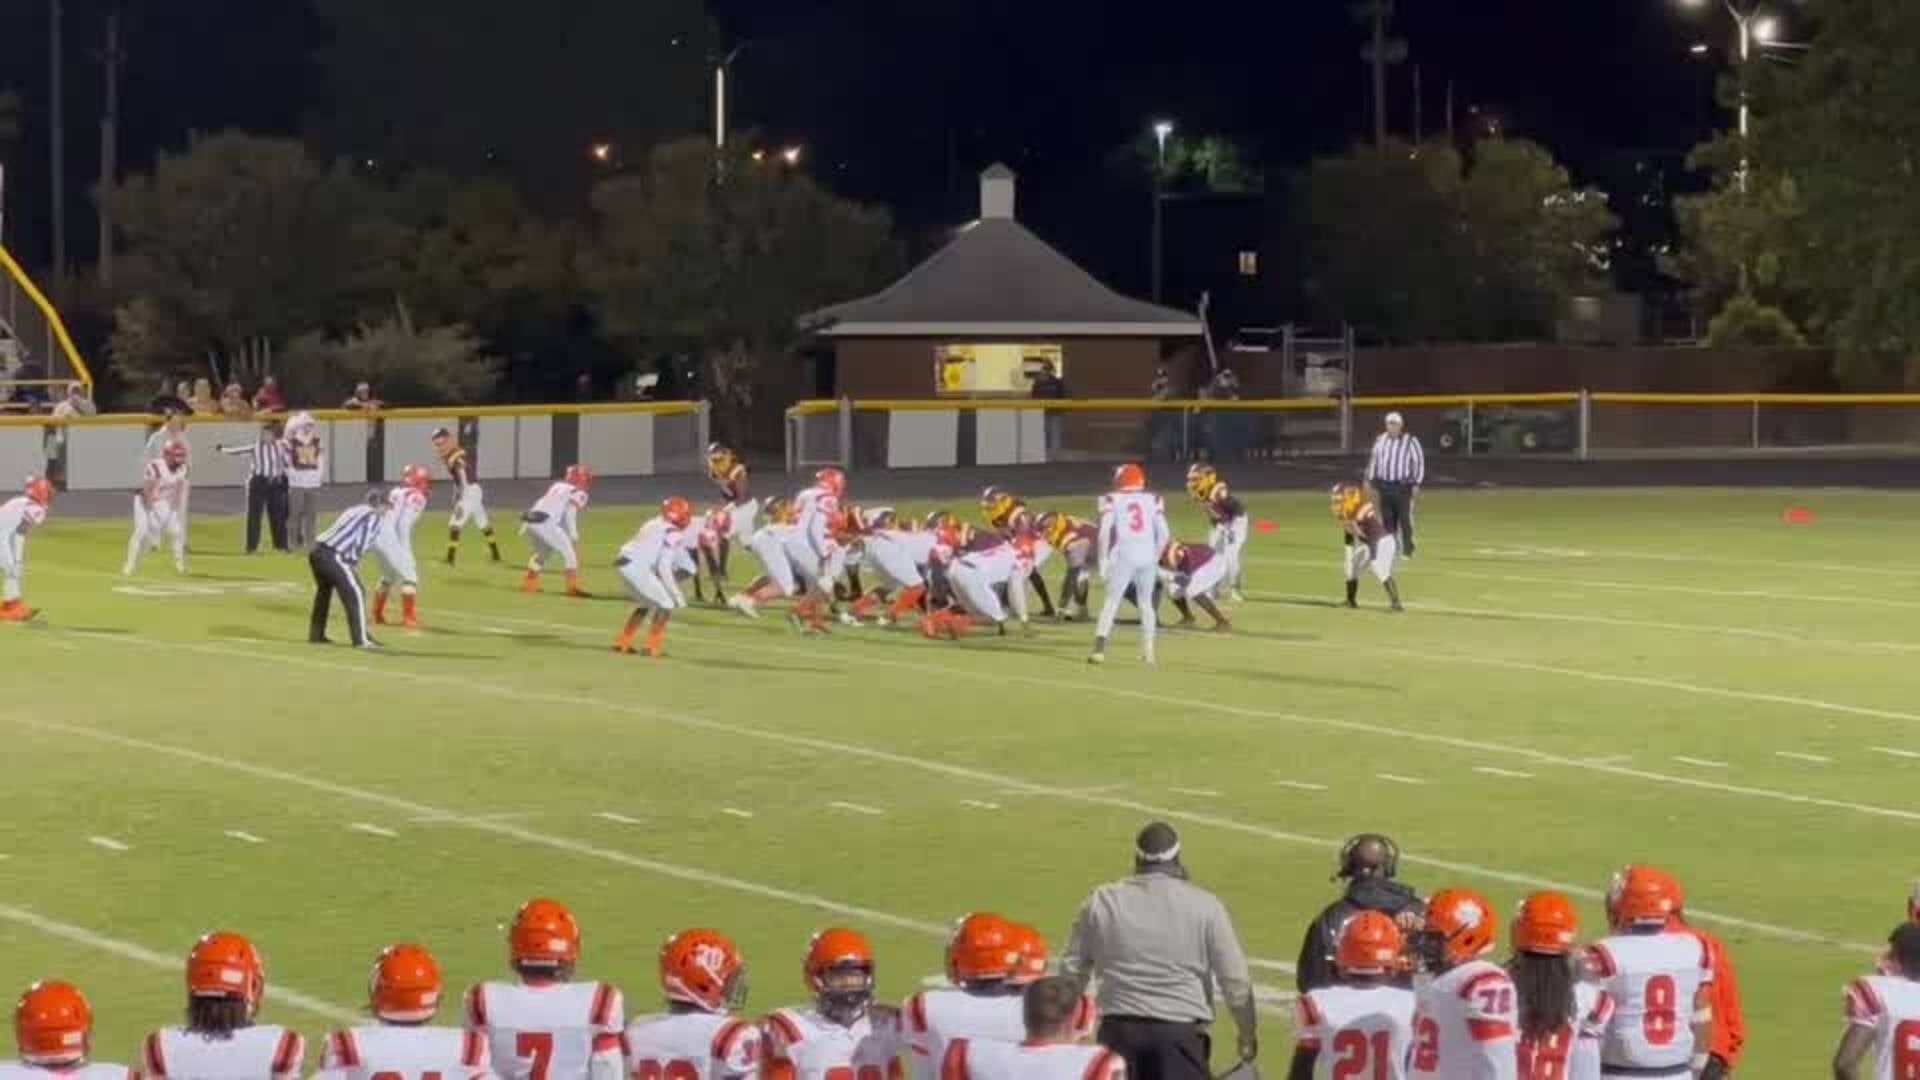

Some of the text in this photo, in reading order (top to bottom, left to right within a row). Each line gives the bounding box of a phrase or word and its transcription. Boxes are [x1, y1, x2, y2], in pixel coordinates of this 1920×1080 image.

[1126, 502, 1144, 533] 3
[1644, 974, 1677, 1045] 8
[516, 1031, 555, 1080] 7
[1332, 1028, 1391, 1080] 21
